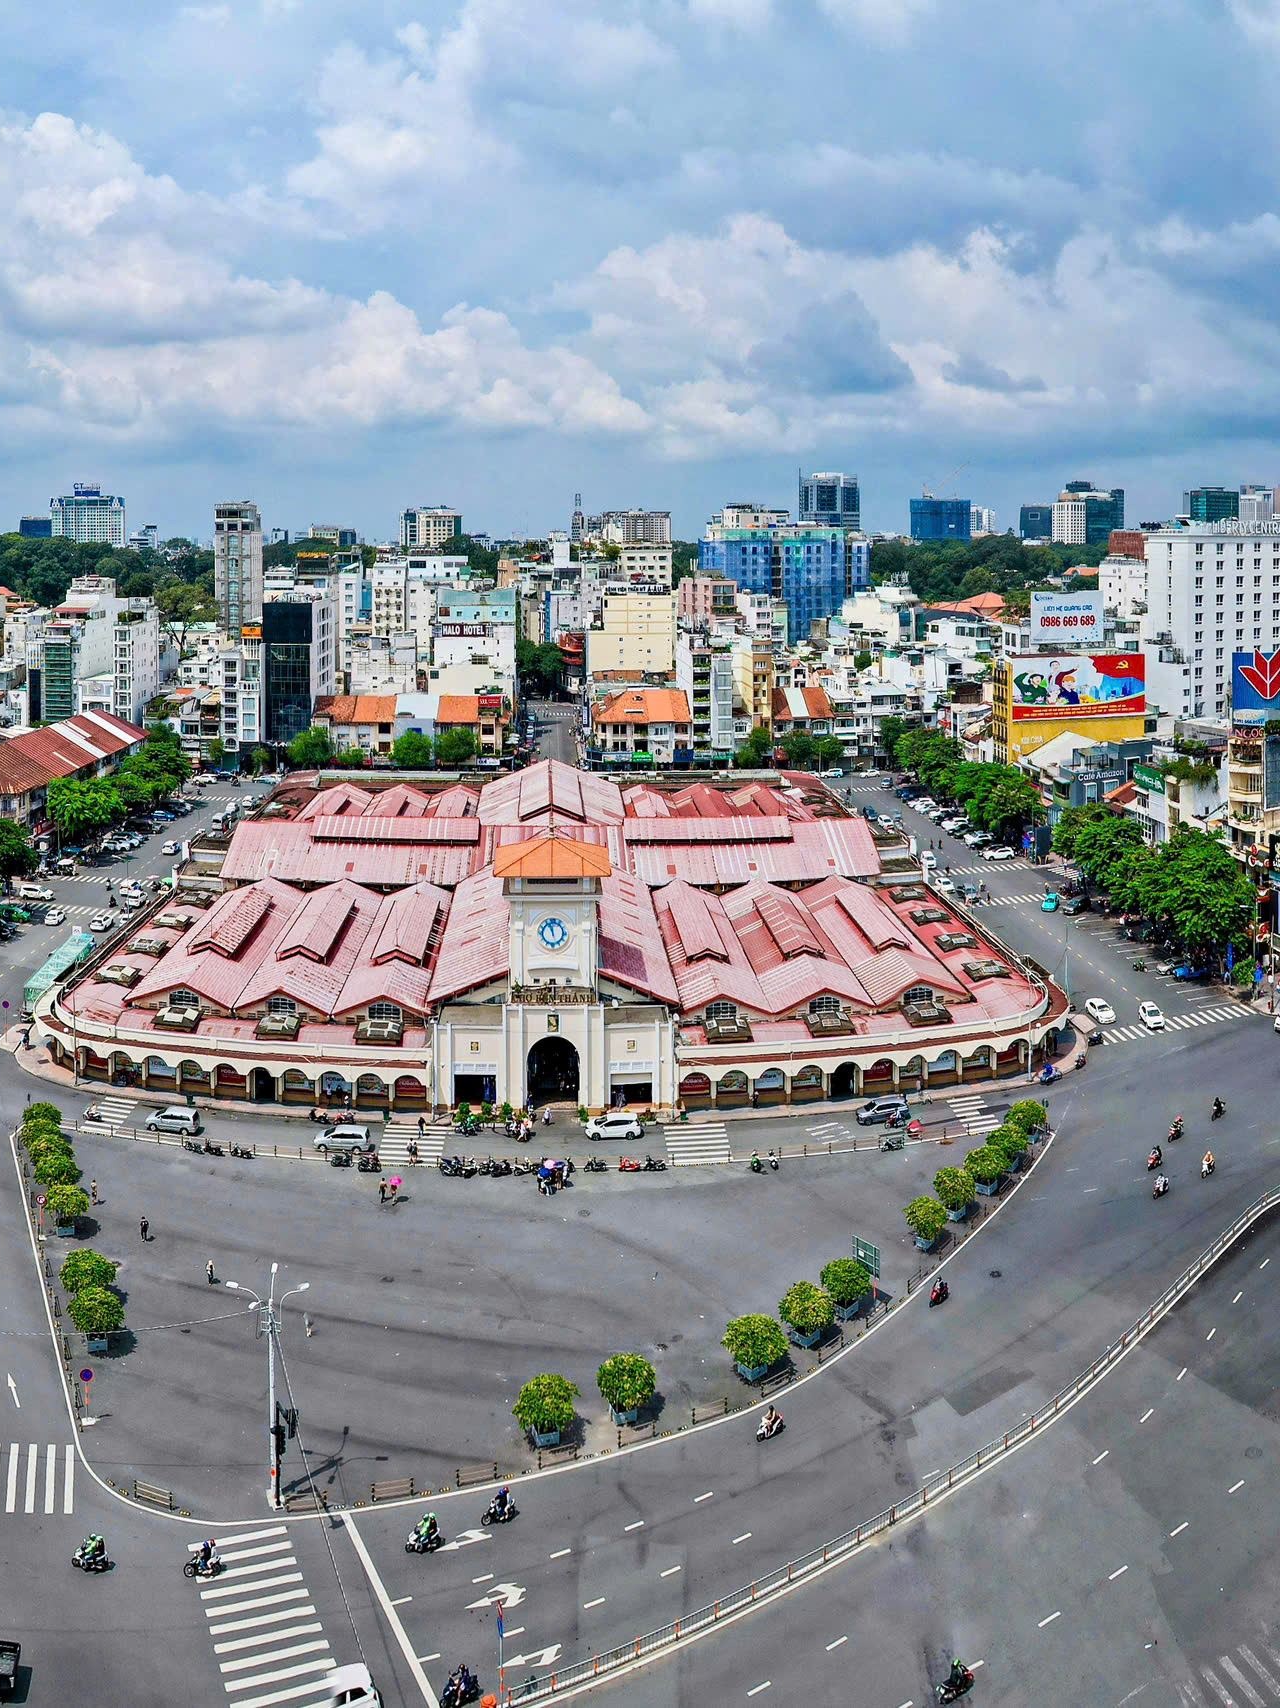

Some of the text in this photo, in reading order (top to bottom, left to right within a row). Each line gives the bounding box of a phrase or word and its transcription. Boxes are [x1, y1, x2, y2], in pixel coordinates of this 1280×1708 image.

[1212, 520, 1248, 534] LIBERTY
[1040, 616, 1061, 627] 0986
[1063, 615, 1078, 626] 669
[442, 625, 485, 635] HALO HOTEL
[1077, 770, 1125, 781] Café Amazon
